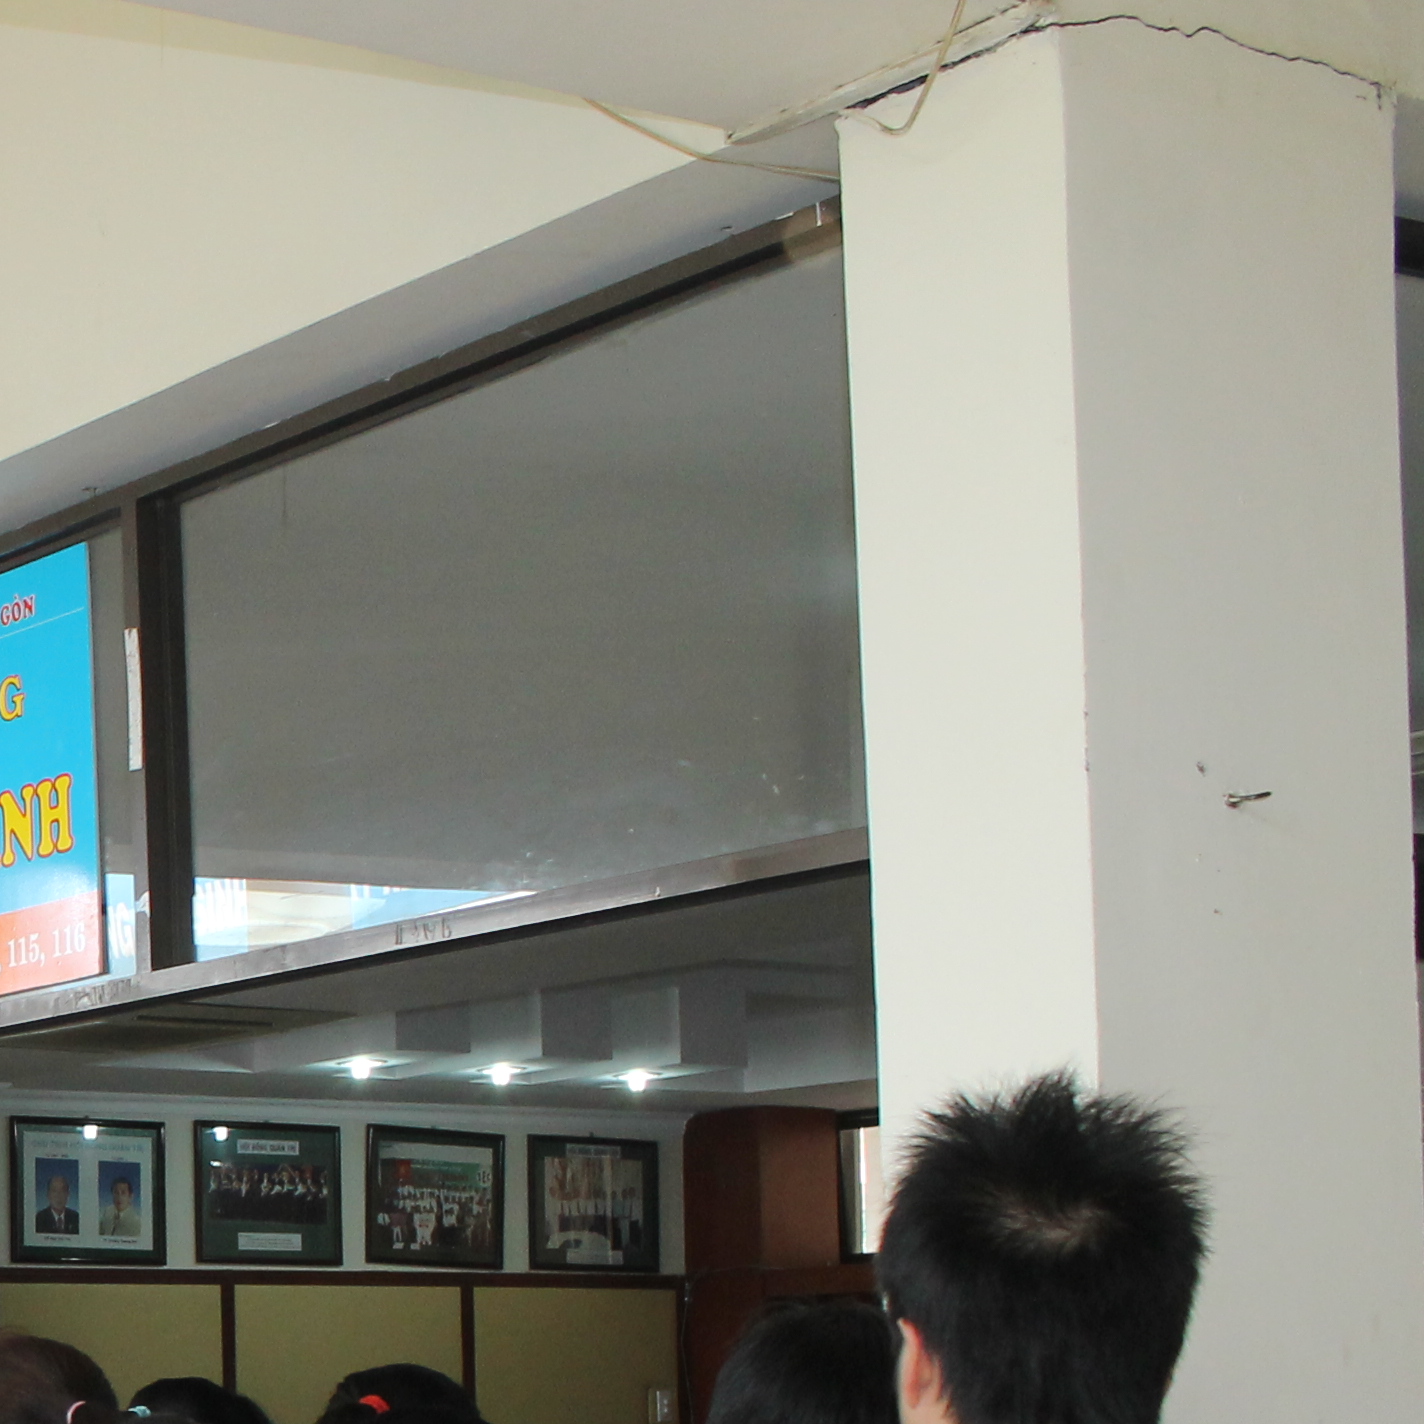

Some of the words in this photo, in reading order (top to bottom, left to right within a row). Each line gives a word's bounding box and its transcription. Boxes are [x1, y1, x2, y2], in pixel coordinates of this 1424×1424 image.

[0, 593, 36, 628] GÒN
[7, 933, 46, 968] 115,
[52, 923, 86, 958] 116
